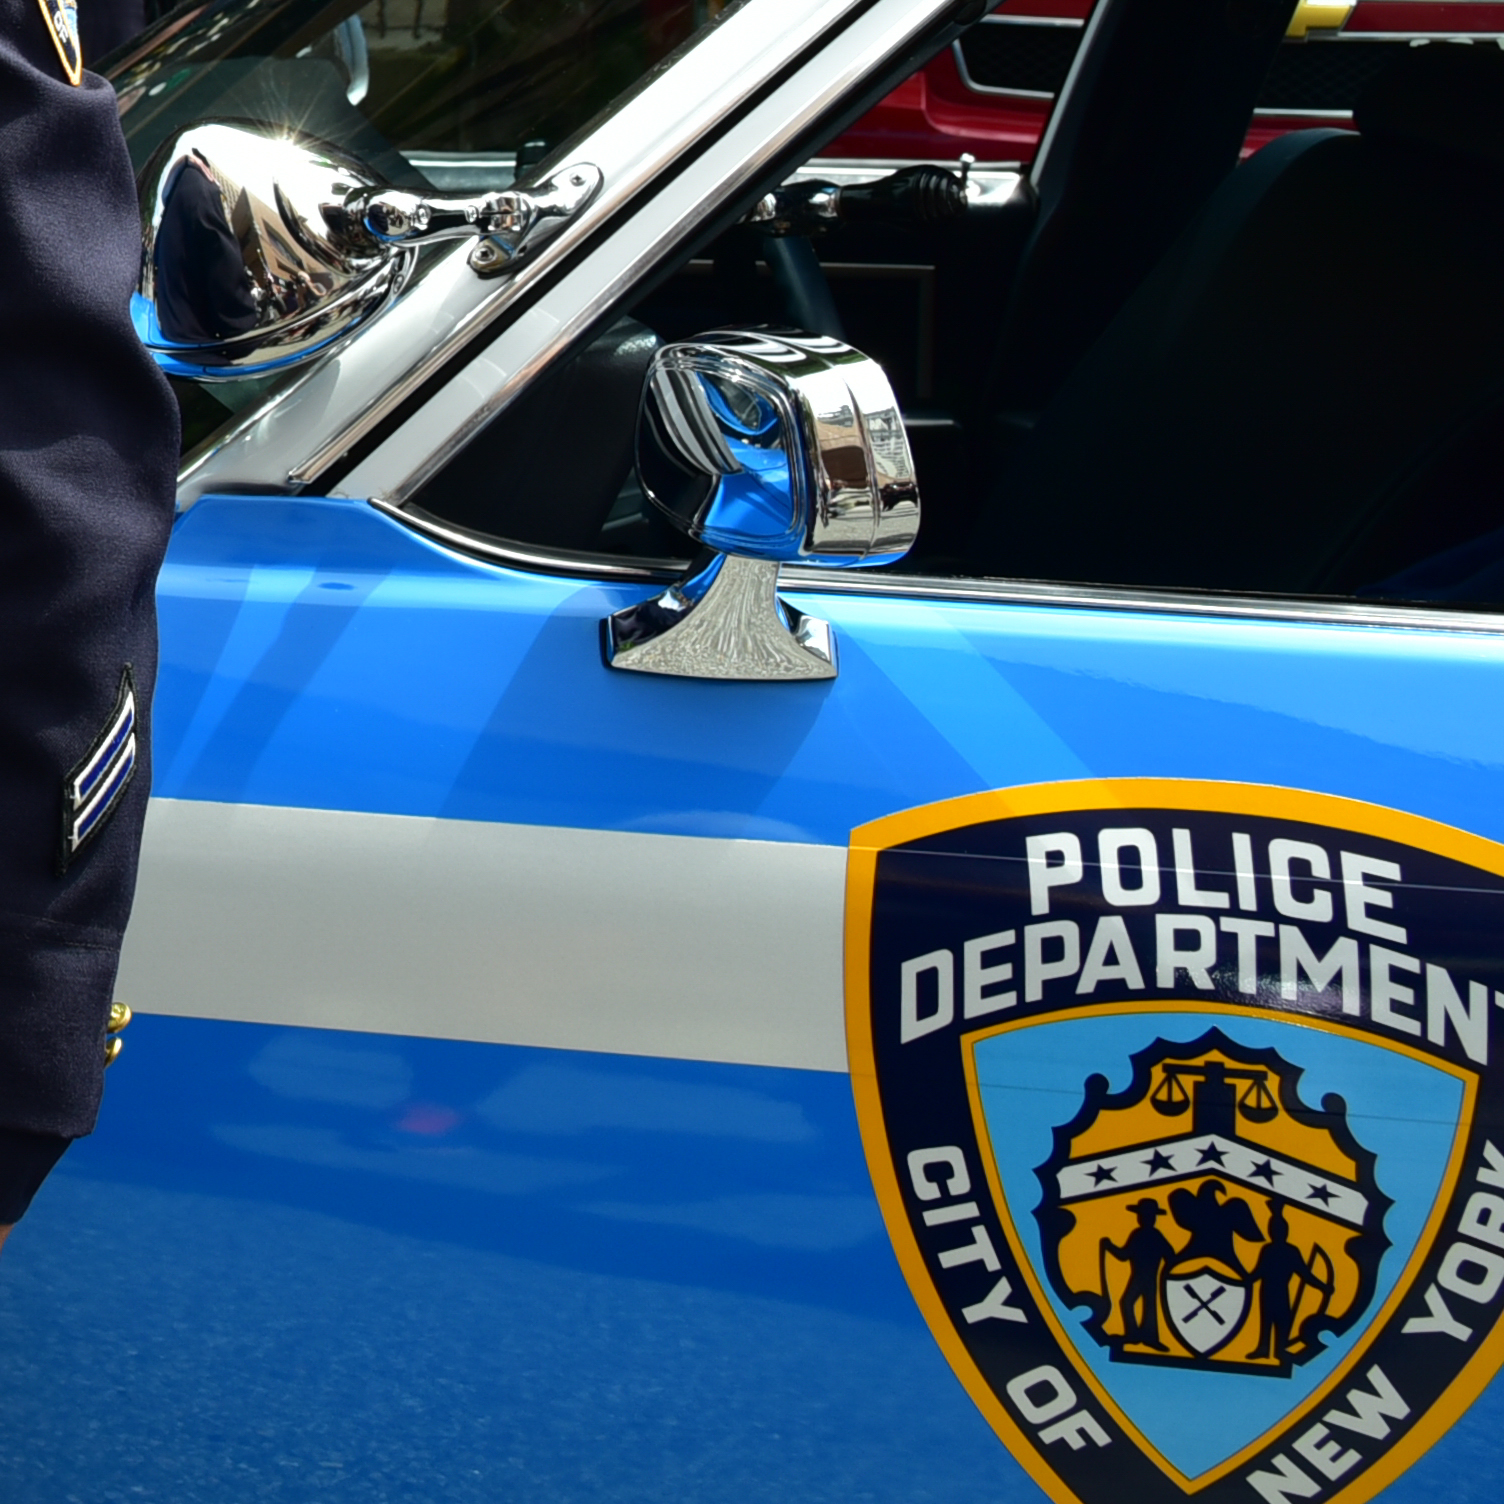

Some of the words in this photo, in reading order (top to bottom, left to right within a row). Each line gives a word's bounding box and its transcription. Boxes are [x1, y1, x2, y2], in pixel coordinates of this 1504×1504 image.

[1025, 827, 1408, 945] POLICE
[901, 913, 1504, 1066] DEPARTMEN
[907, 1145, 1029, 1325] CITY
[1006, 1364, 1113, 1452] OF
[1245, 1363, 1412, 1504] NEW
